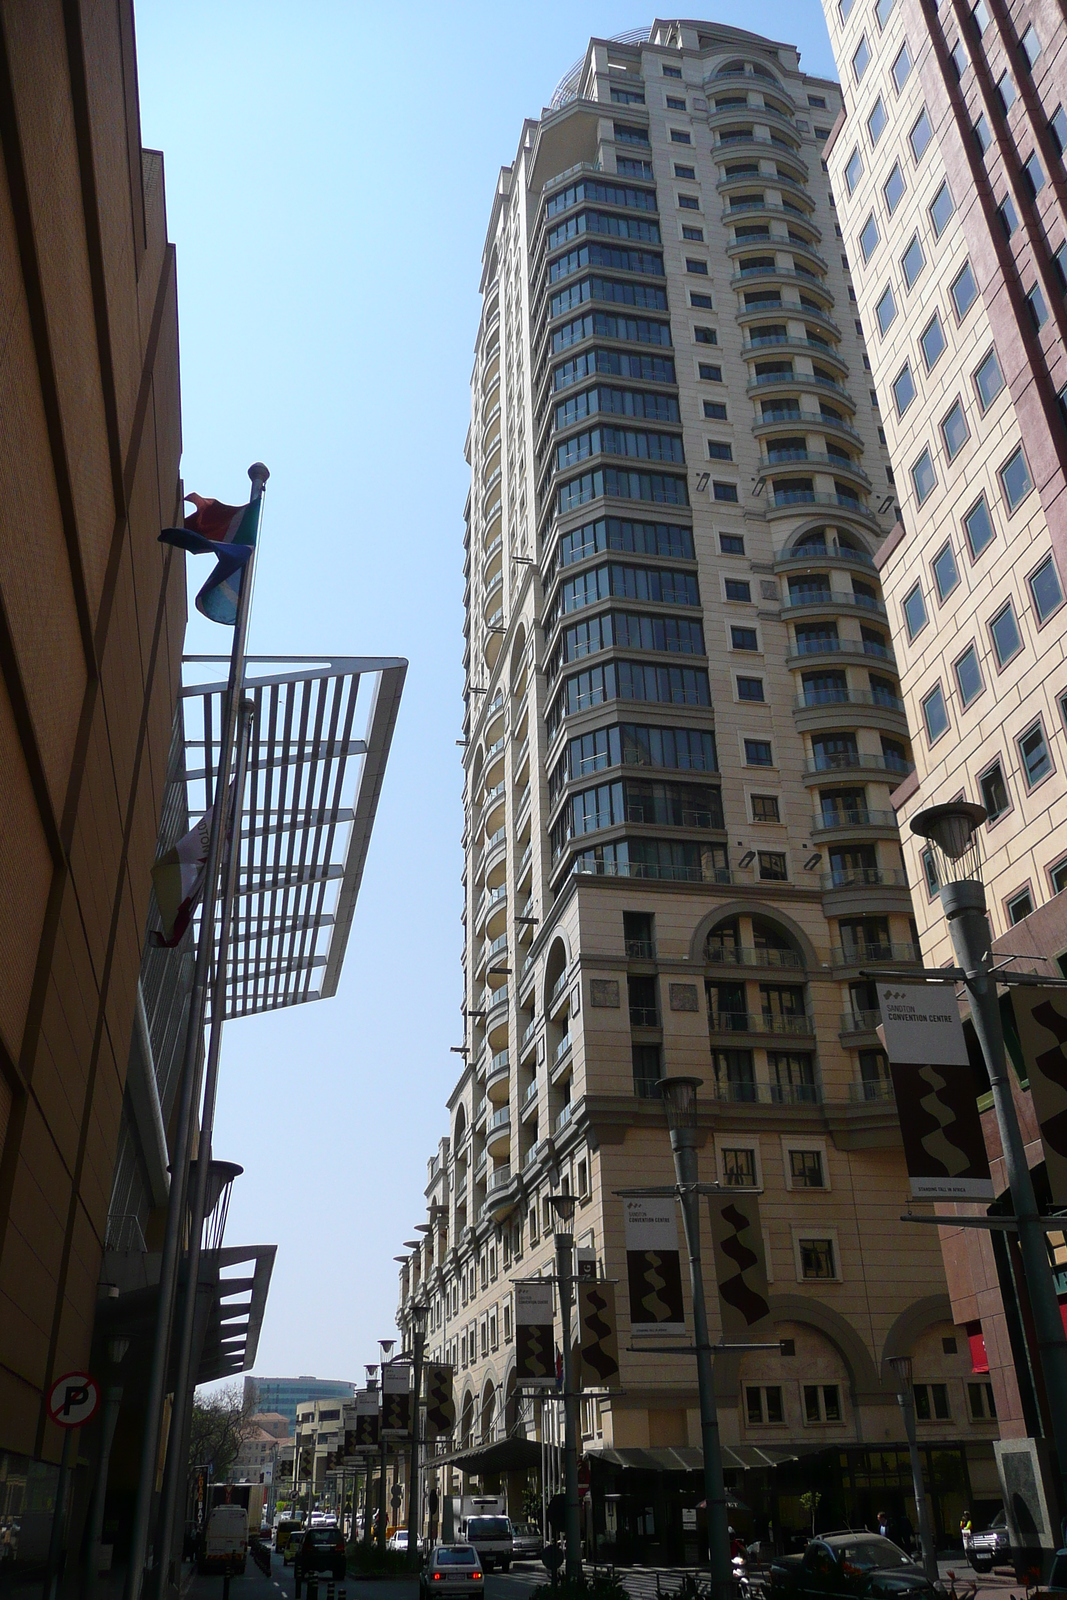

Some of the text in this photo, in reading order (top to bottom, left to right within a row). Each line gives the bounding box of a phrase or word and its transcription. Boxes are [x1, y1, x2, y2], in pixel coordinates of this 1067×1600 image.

[886, 1004, 915, 1013] SANDTON
[888, 1013, 953, 1023] CONVENTION CENTRE
[63, 1386, 89, 1416] P
